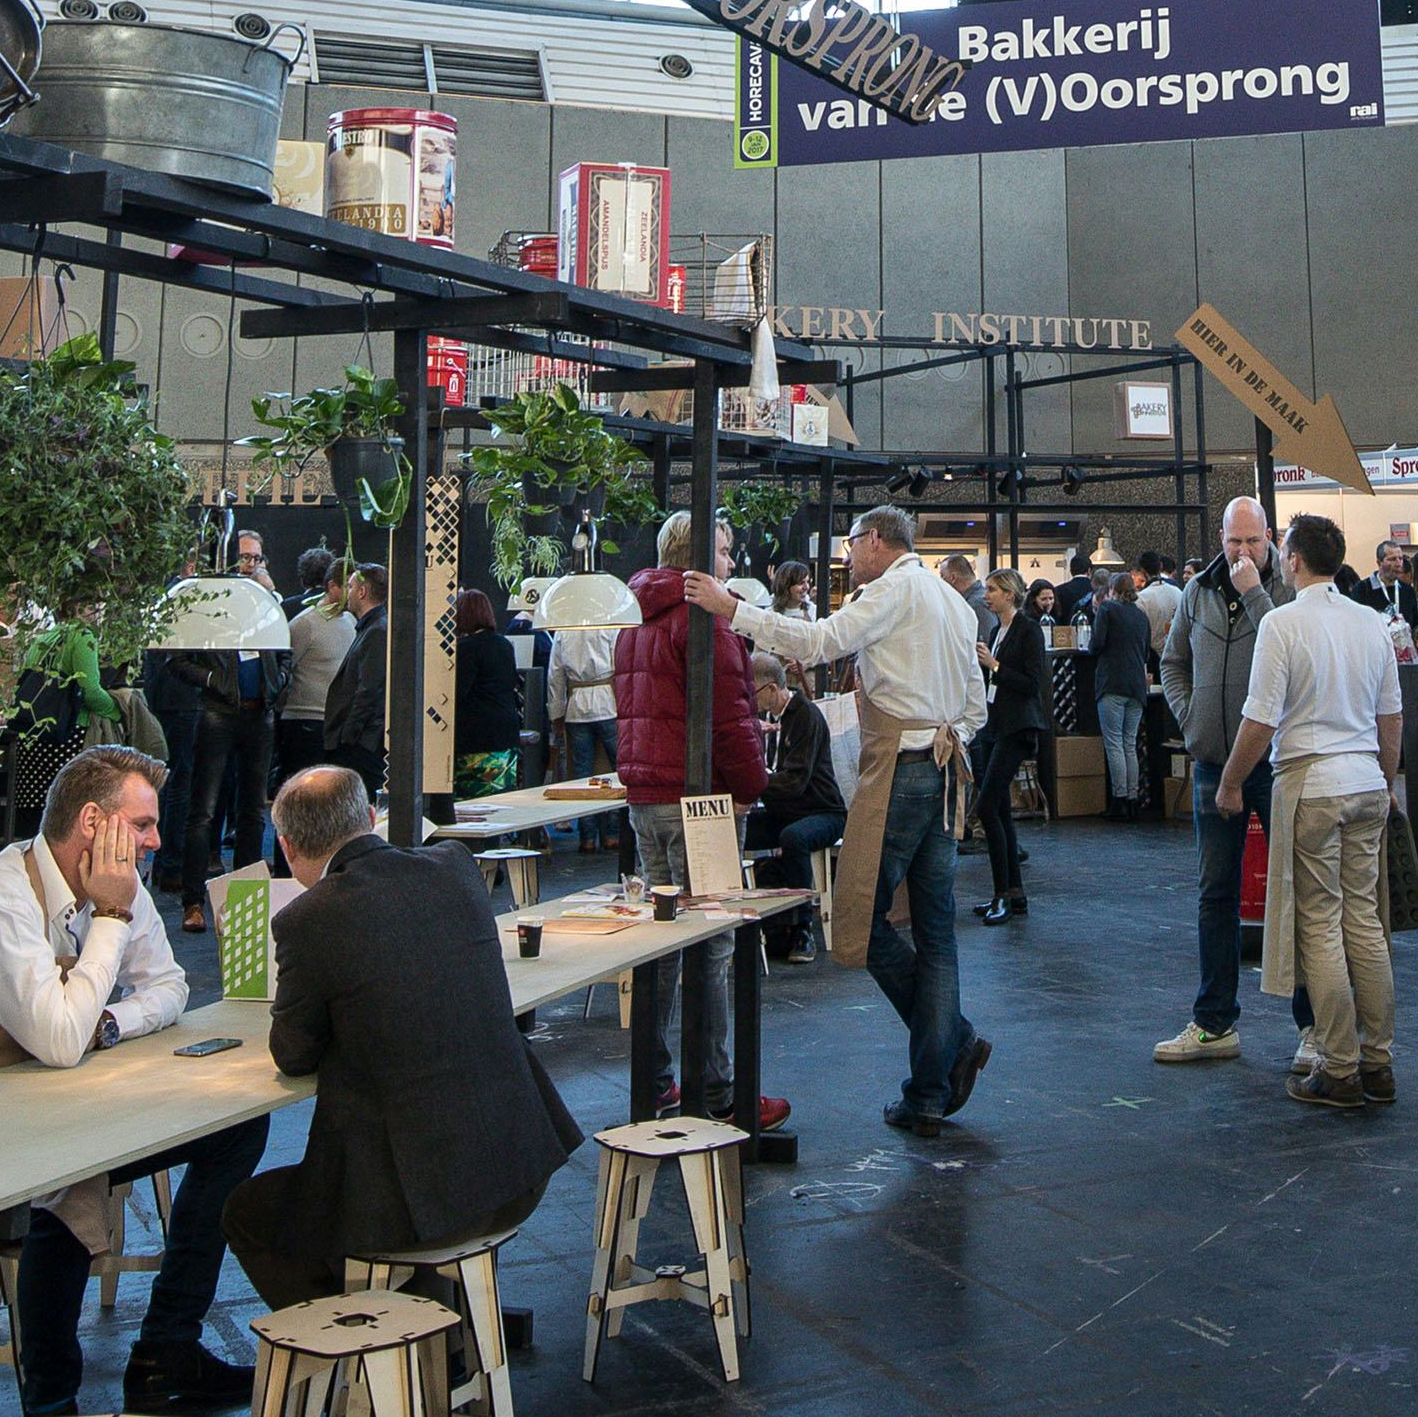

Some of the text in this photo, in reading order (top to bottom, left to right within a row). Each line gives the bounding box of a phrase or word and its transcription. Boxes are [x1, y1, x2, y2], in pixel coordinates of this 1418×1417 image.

[958, 7, 1172, 64] Bakkerij
[749, 41, 763, 122] HORECAV
[798, 94, 887, 132] van
[986, 60, 1352, 126] (V)Oorsprong
[334, 130, 374, 148] ESTRO
[639, 211, 648, 263] ZEELANDIA
[768, 305, 1153, 350] KERY INSTITUTE
[1190, 319, 1311, 435] HIER IN DE MAAK
[685, 797, 729, 819] MENU
